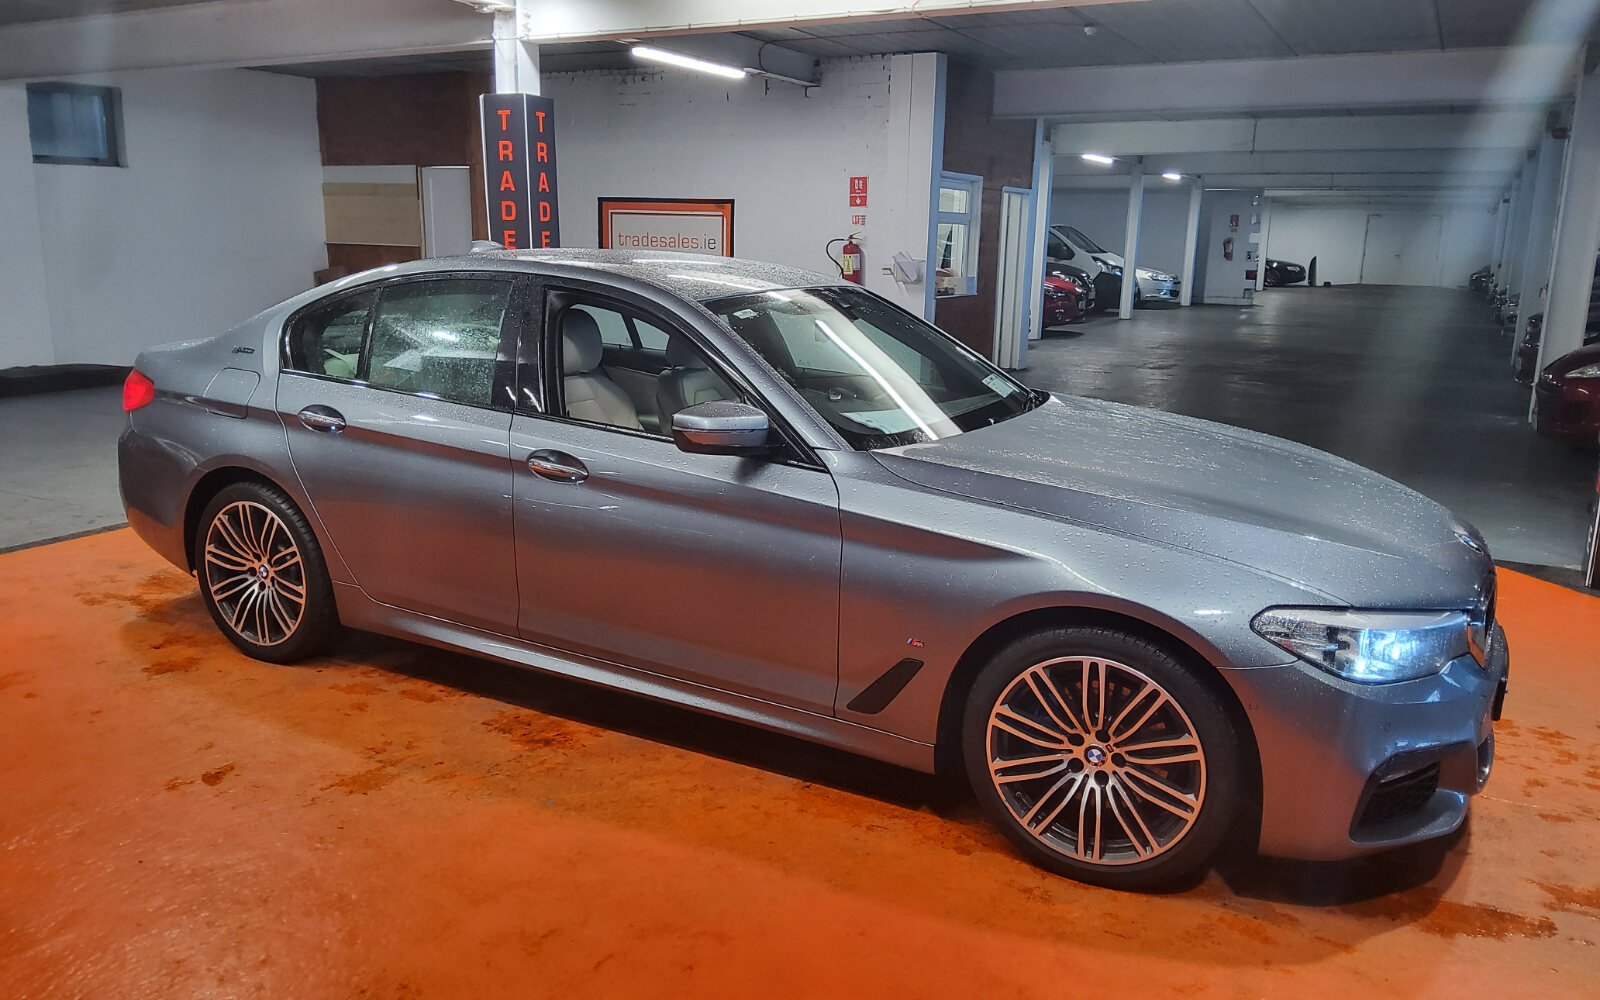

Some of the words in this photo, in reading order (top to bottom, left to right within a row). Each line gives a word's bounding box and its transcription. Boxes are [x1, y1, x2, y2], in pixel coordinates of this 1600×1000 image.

[497, 109, 517, 250] TRADE
[535, 111, 551, 249] TRADE
[618, 231, 717, 250] tradesales.ie
